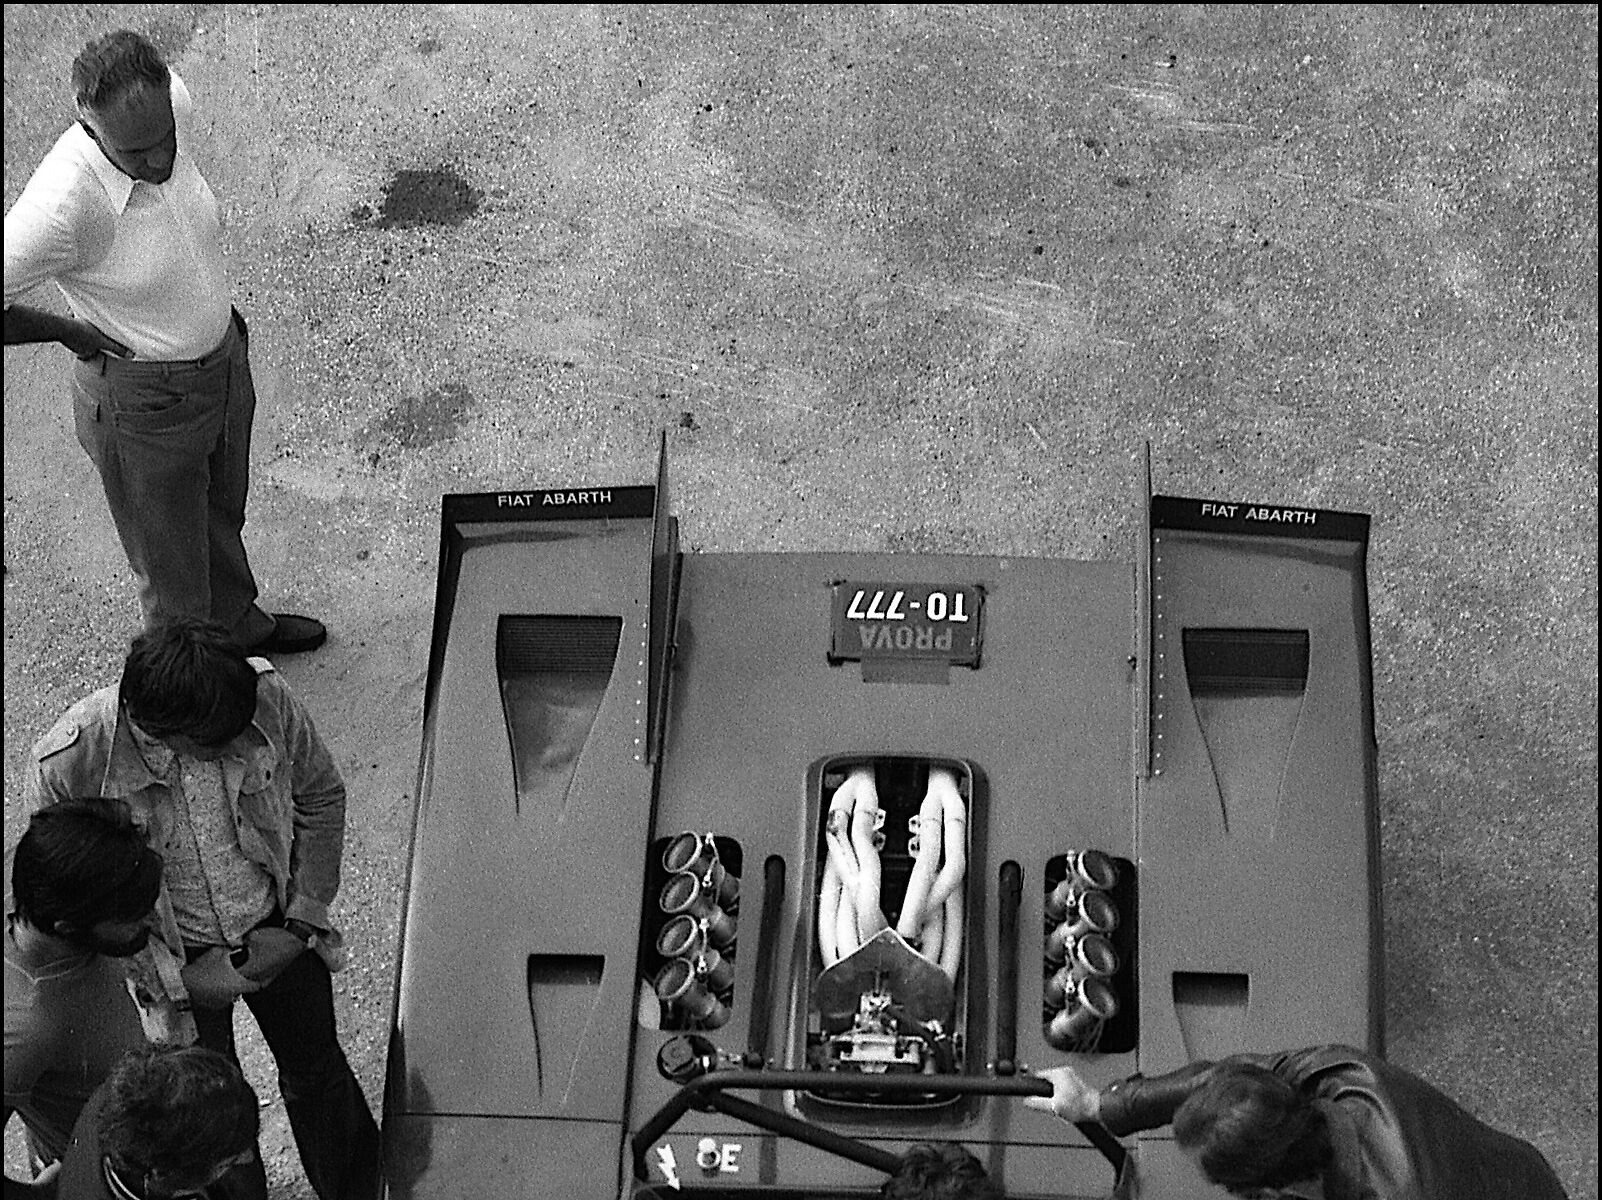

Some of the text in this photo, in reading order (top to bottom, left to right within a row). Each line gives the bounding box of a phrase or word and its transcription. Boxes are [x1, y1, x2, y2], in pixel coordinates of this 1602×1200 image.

[497, 491, 612, 508] FIAT ABARTH
[1201, 503, 1317, 524] FIAT ABARTH
[847, 591, 968, 621] TO-777
[859, 626, 952, 650] PROVA
